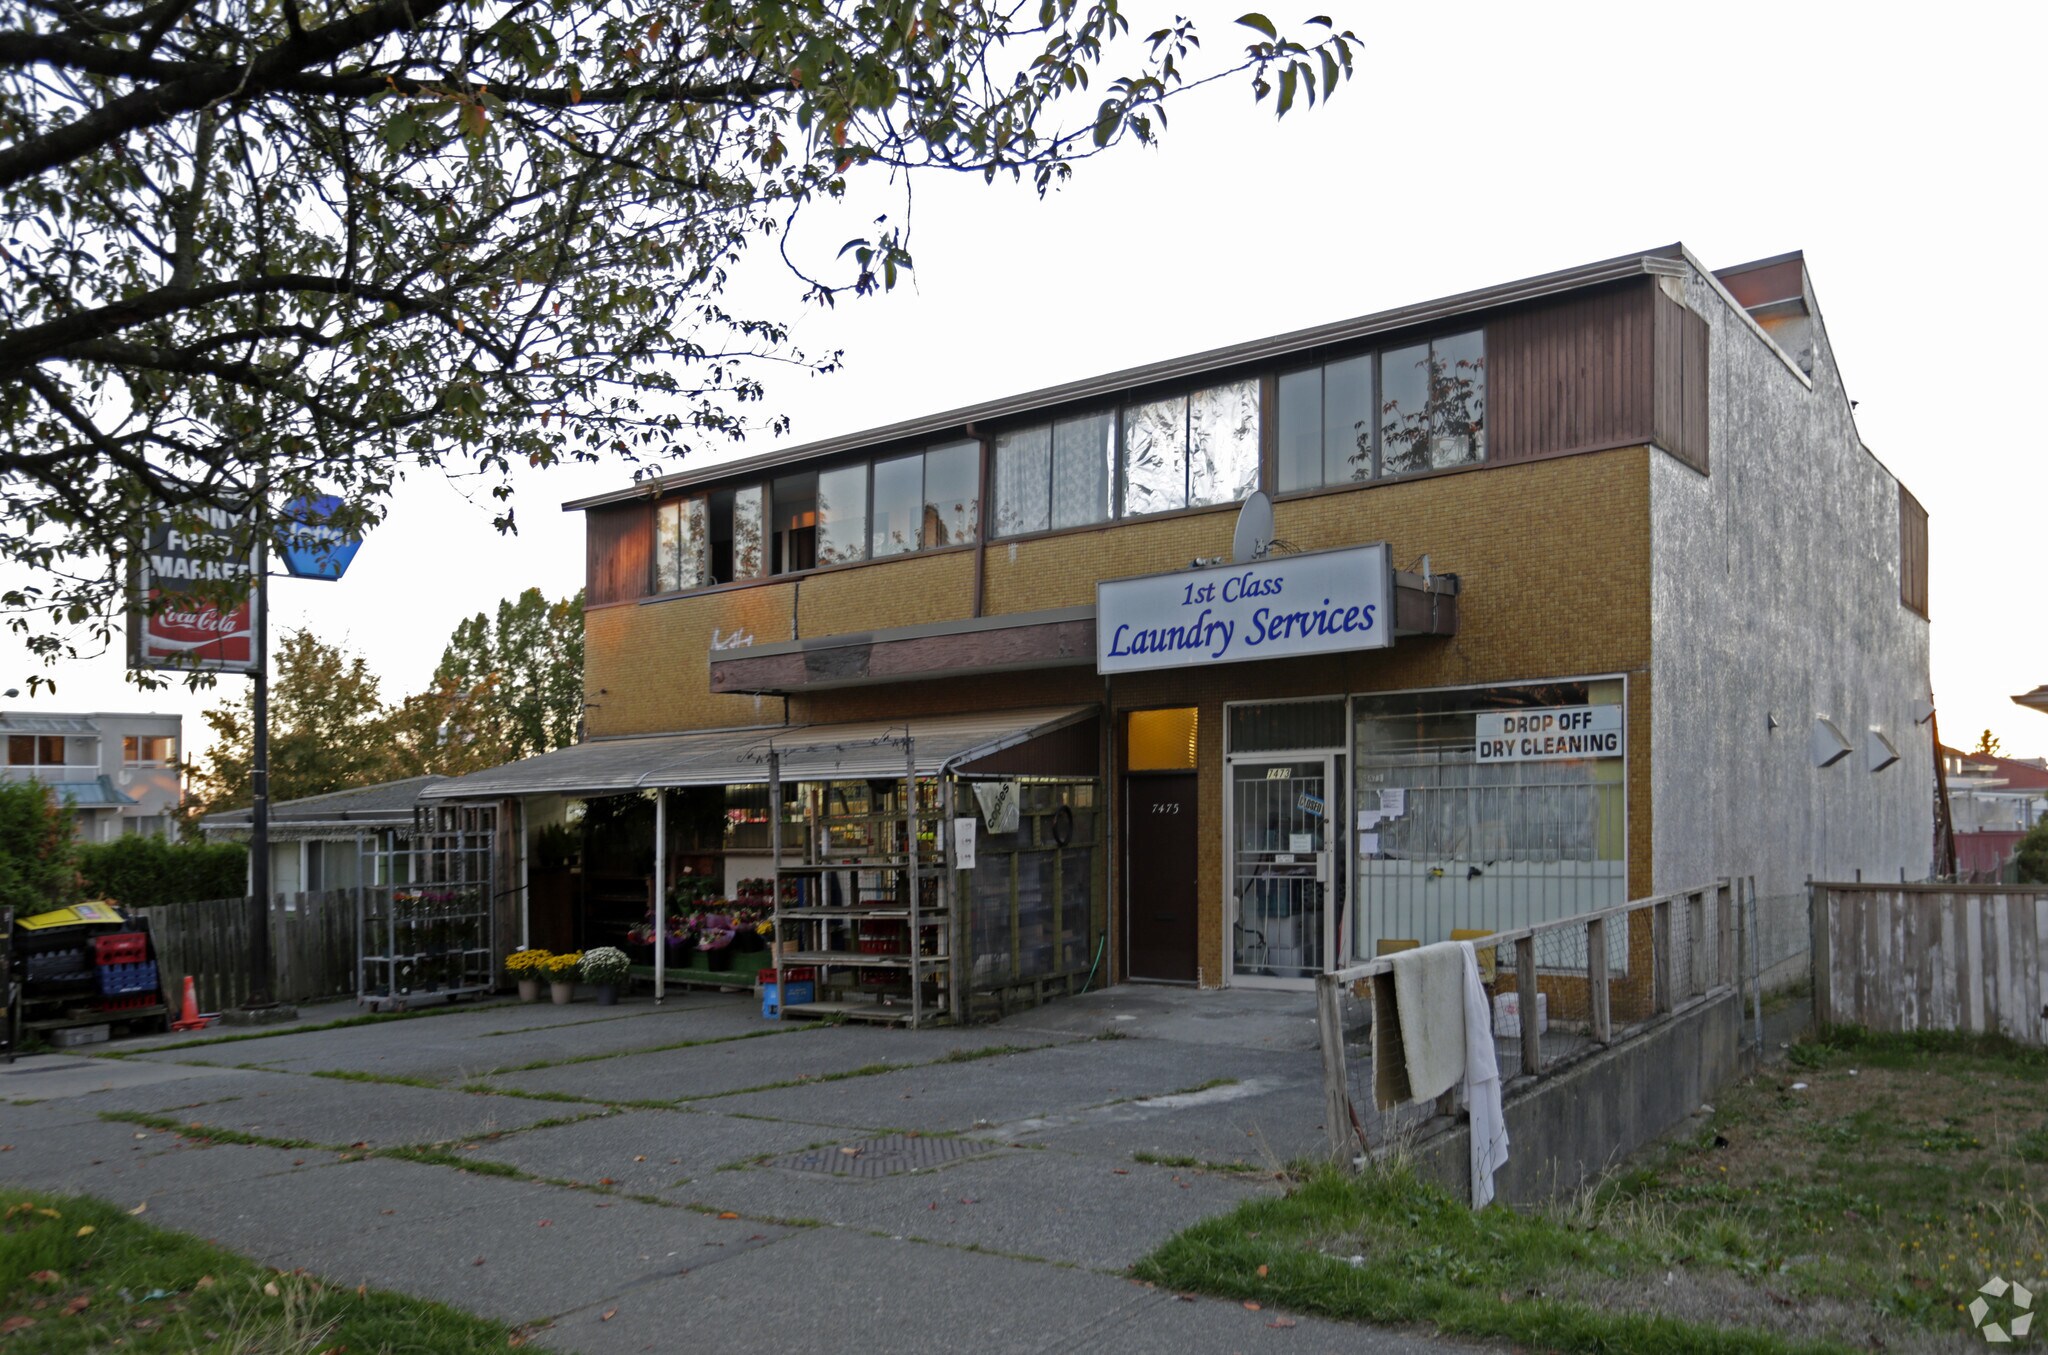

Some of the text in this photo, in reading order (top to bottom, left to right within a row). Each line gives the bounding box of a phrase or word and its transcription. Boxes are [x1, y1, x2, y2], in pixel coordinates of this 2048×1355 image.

[150, 555, 249, 583] MARKET
[1182, 571, 1284, 606] 1st Class
[1107, 598, 1376, 658] Laundry Services
[1503, 711, 1592, 734] DROP OFF
[1480, 732, 1617, 758] DRY CLEANING
[987, 783, 1010, 829] copies
[1151, 803, 1180, 815] 7475
